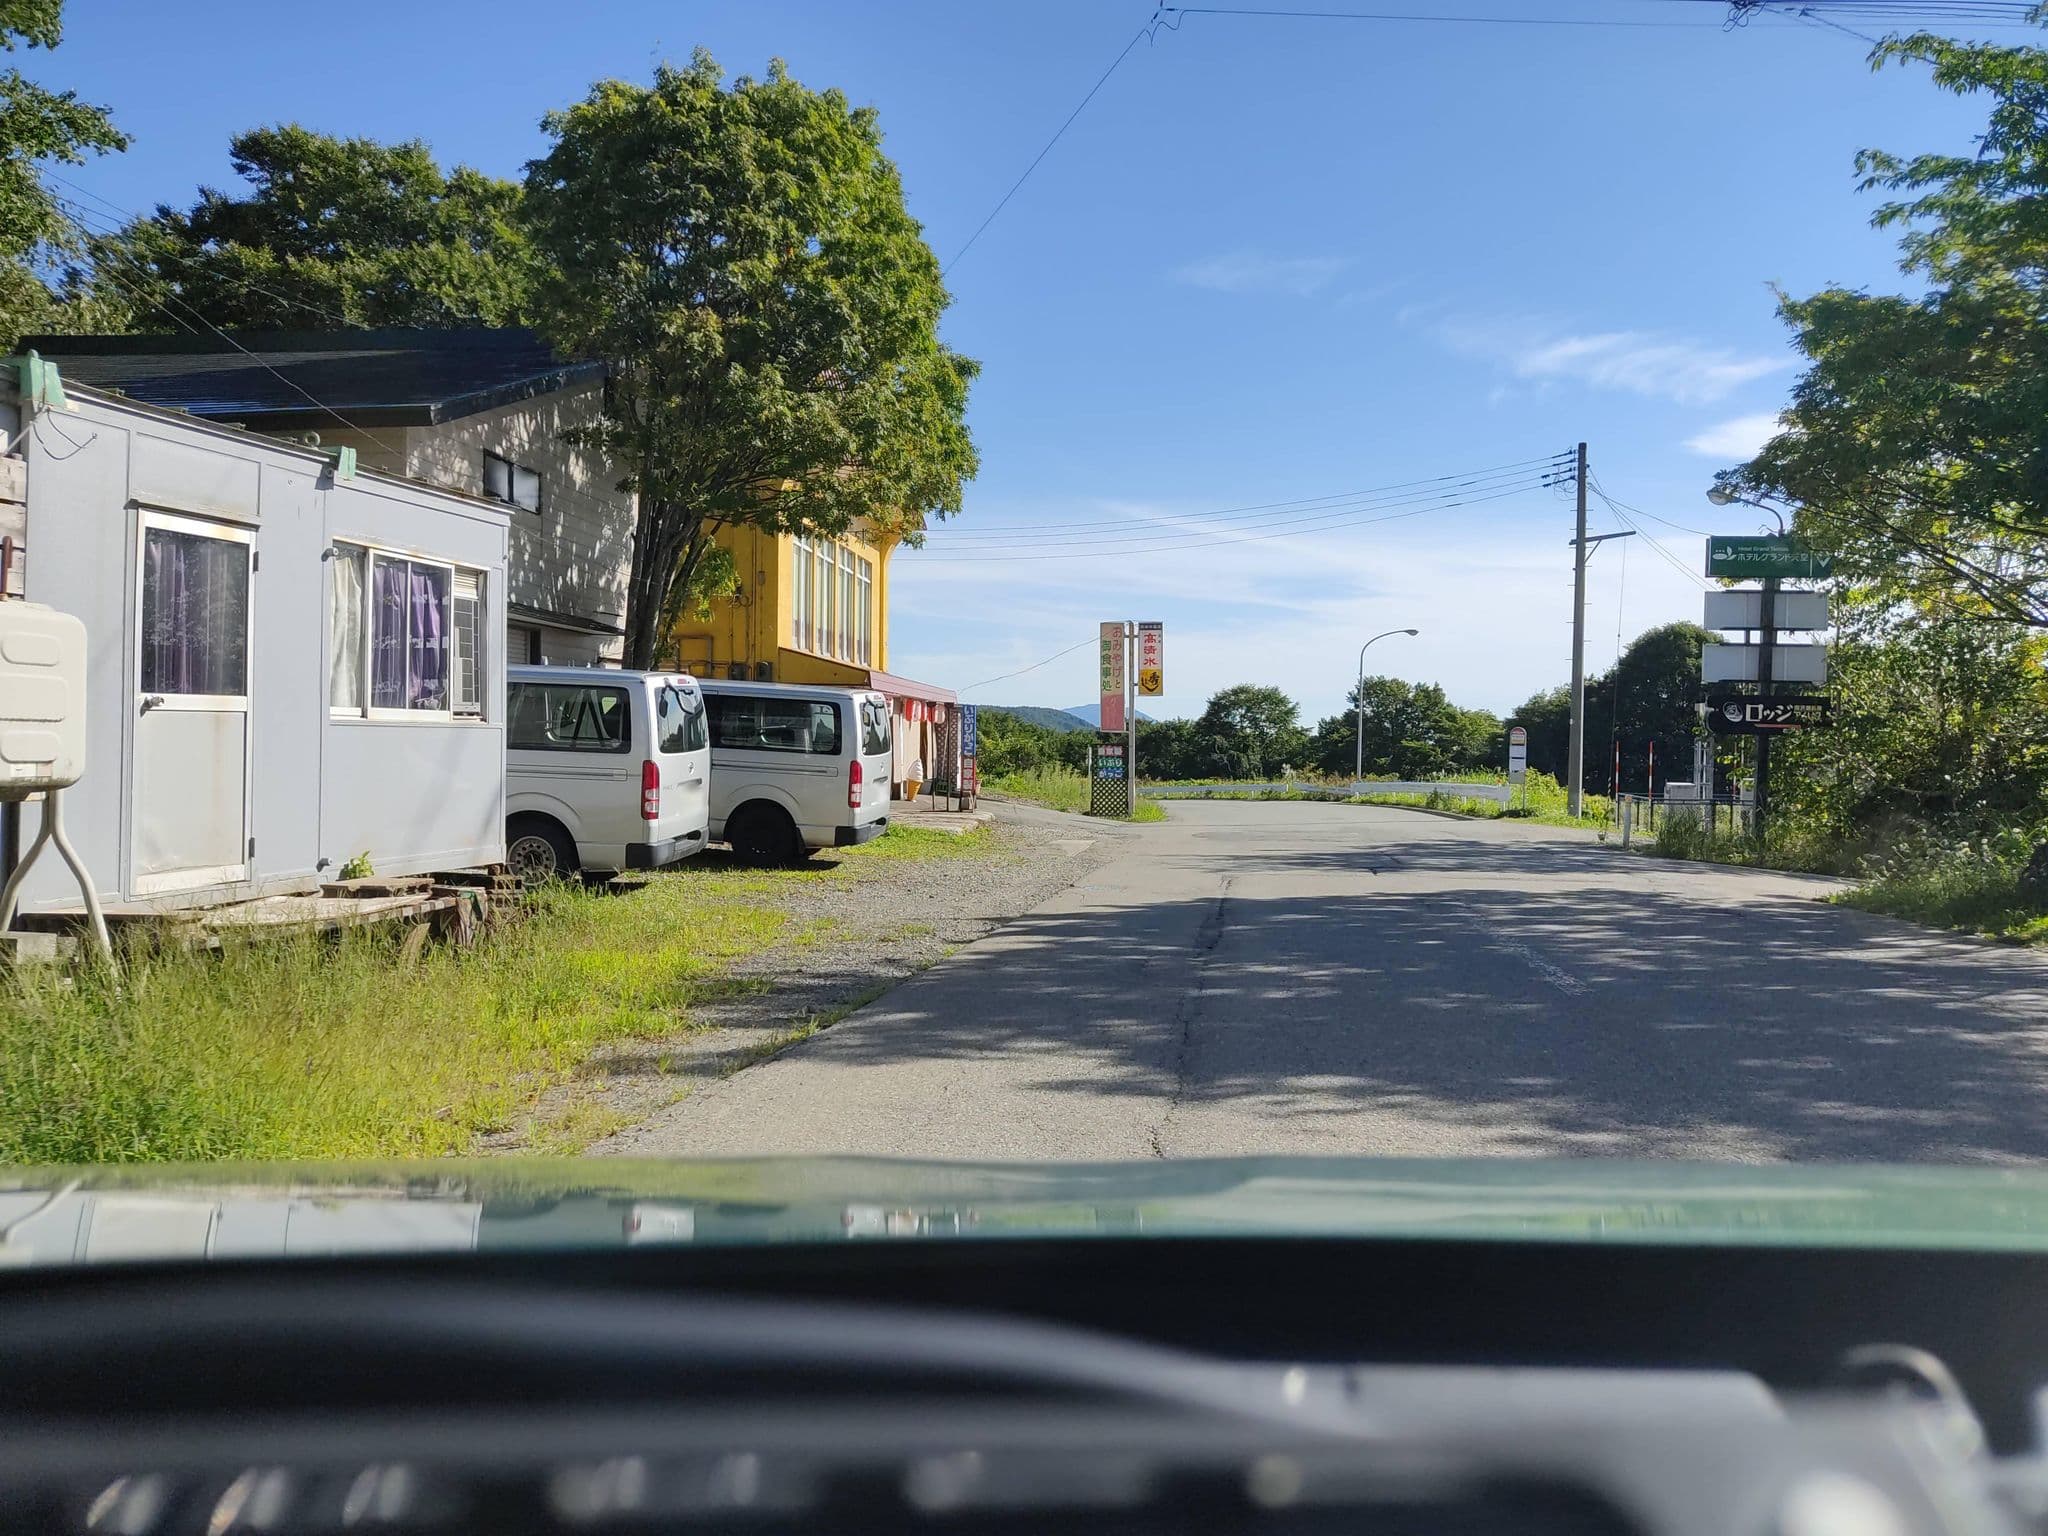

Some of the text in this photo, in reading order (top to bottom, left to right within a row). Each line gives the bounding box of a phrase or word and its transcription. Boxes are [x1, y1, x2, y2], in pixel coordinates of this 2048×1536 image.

[1101, 640, 1111, 691] 御食事処
[1112, 627, 1122, 689] おみやげと
[1745, 703, 1793, 722] ロッジ
